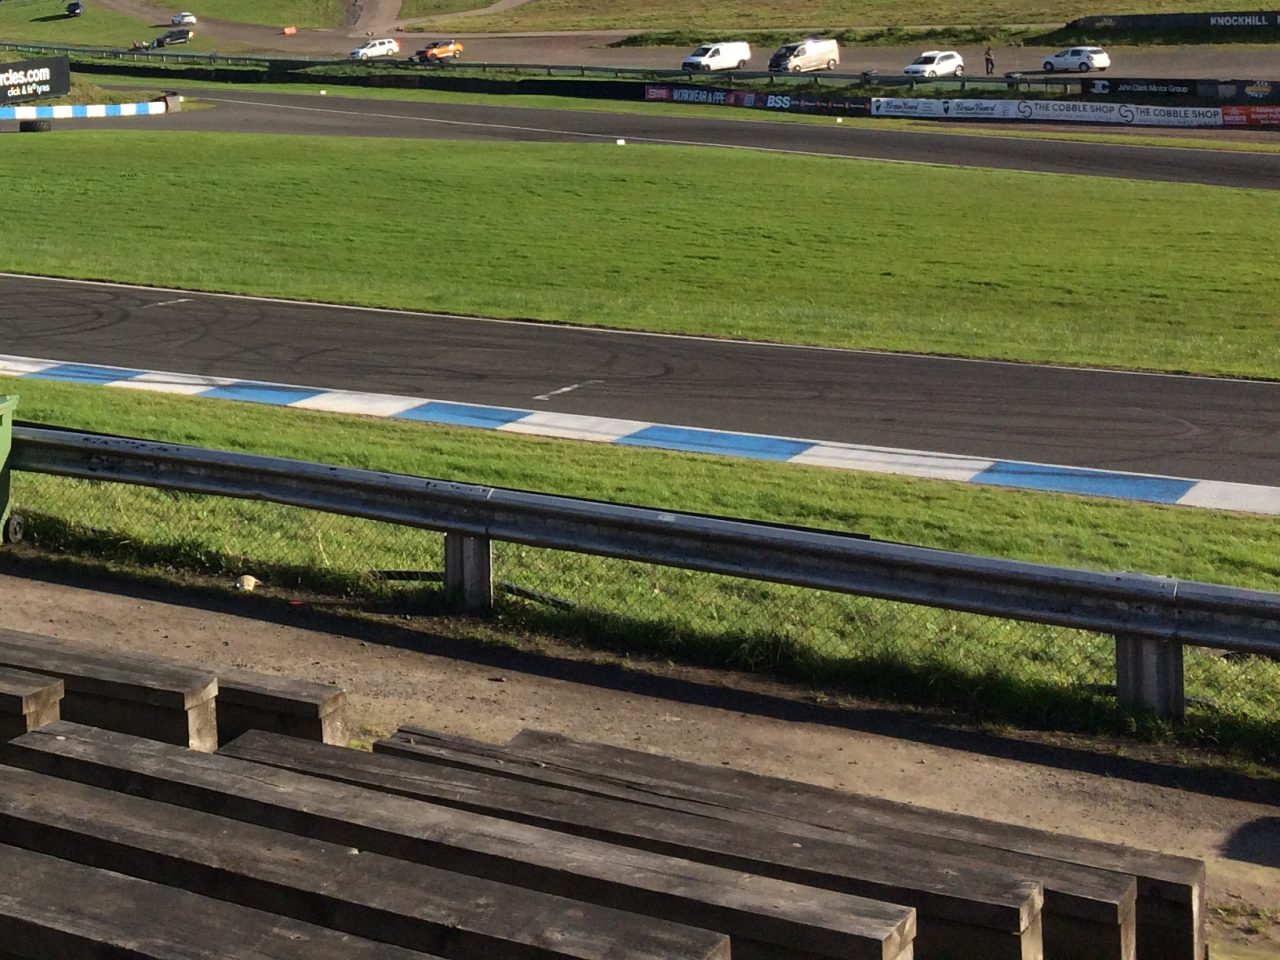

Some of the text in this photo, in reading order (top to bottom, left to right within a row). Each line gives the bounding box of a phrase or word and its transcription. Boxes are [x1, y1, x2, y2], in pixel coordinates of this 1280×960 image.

[1210, 15, 1269, 26] KNOCKHILL
[7, 86, 21, 97] click
[21, 85, 27, 95] &
[672, 88, 707, 102] WORKWEAR
[1168, 85, 1189, 93] Group
[766, 95, 791, 109] BSS
[1034, 103, 1115, 114] THE COBBLE SHOP
[1135, 107, 1220, 119] THE COBBLE SHOP
